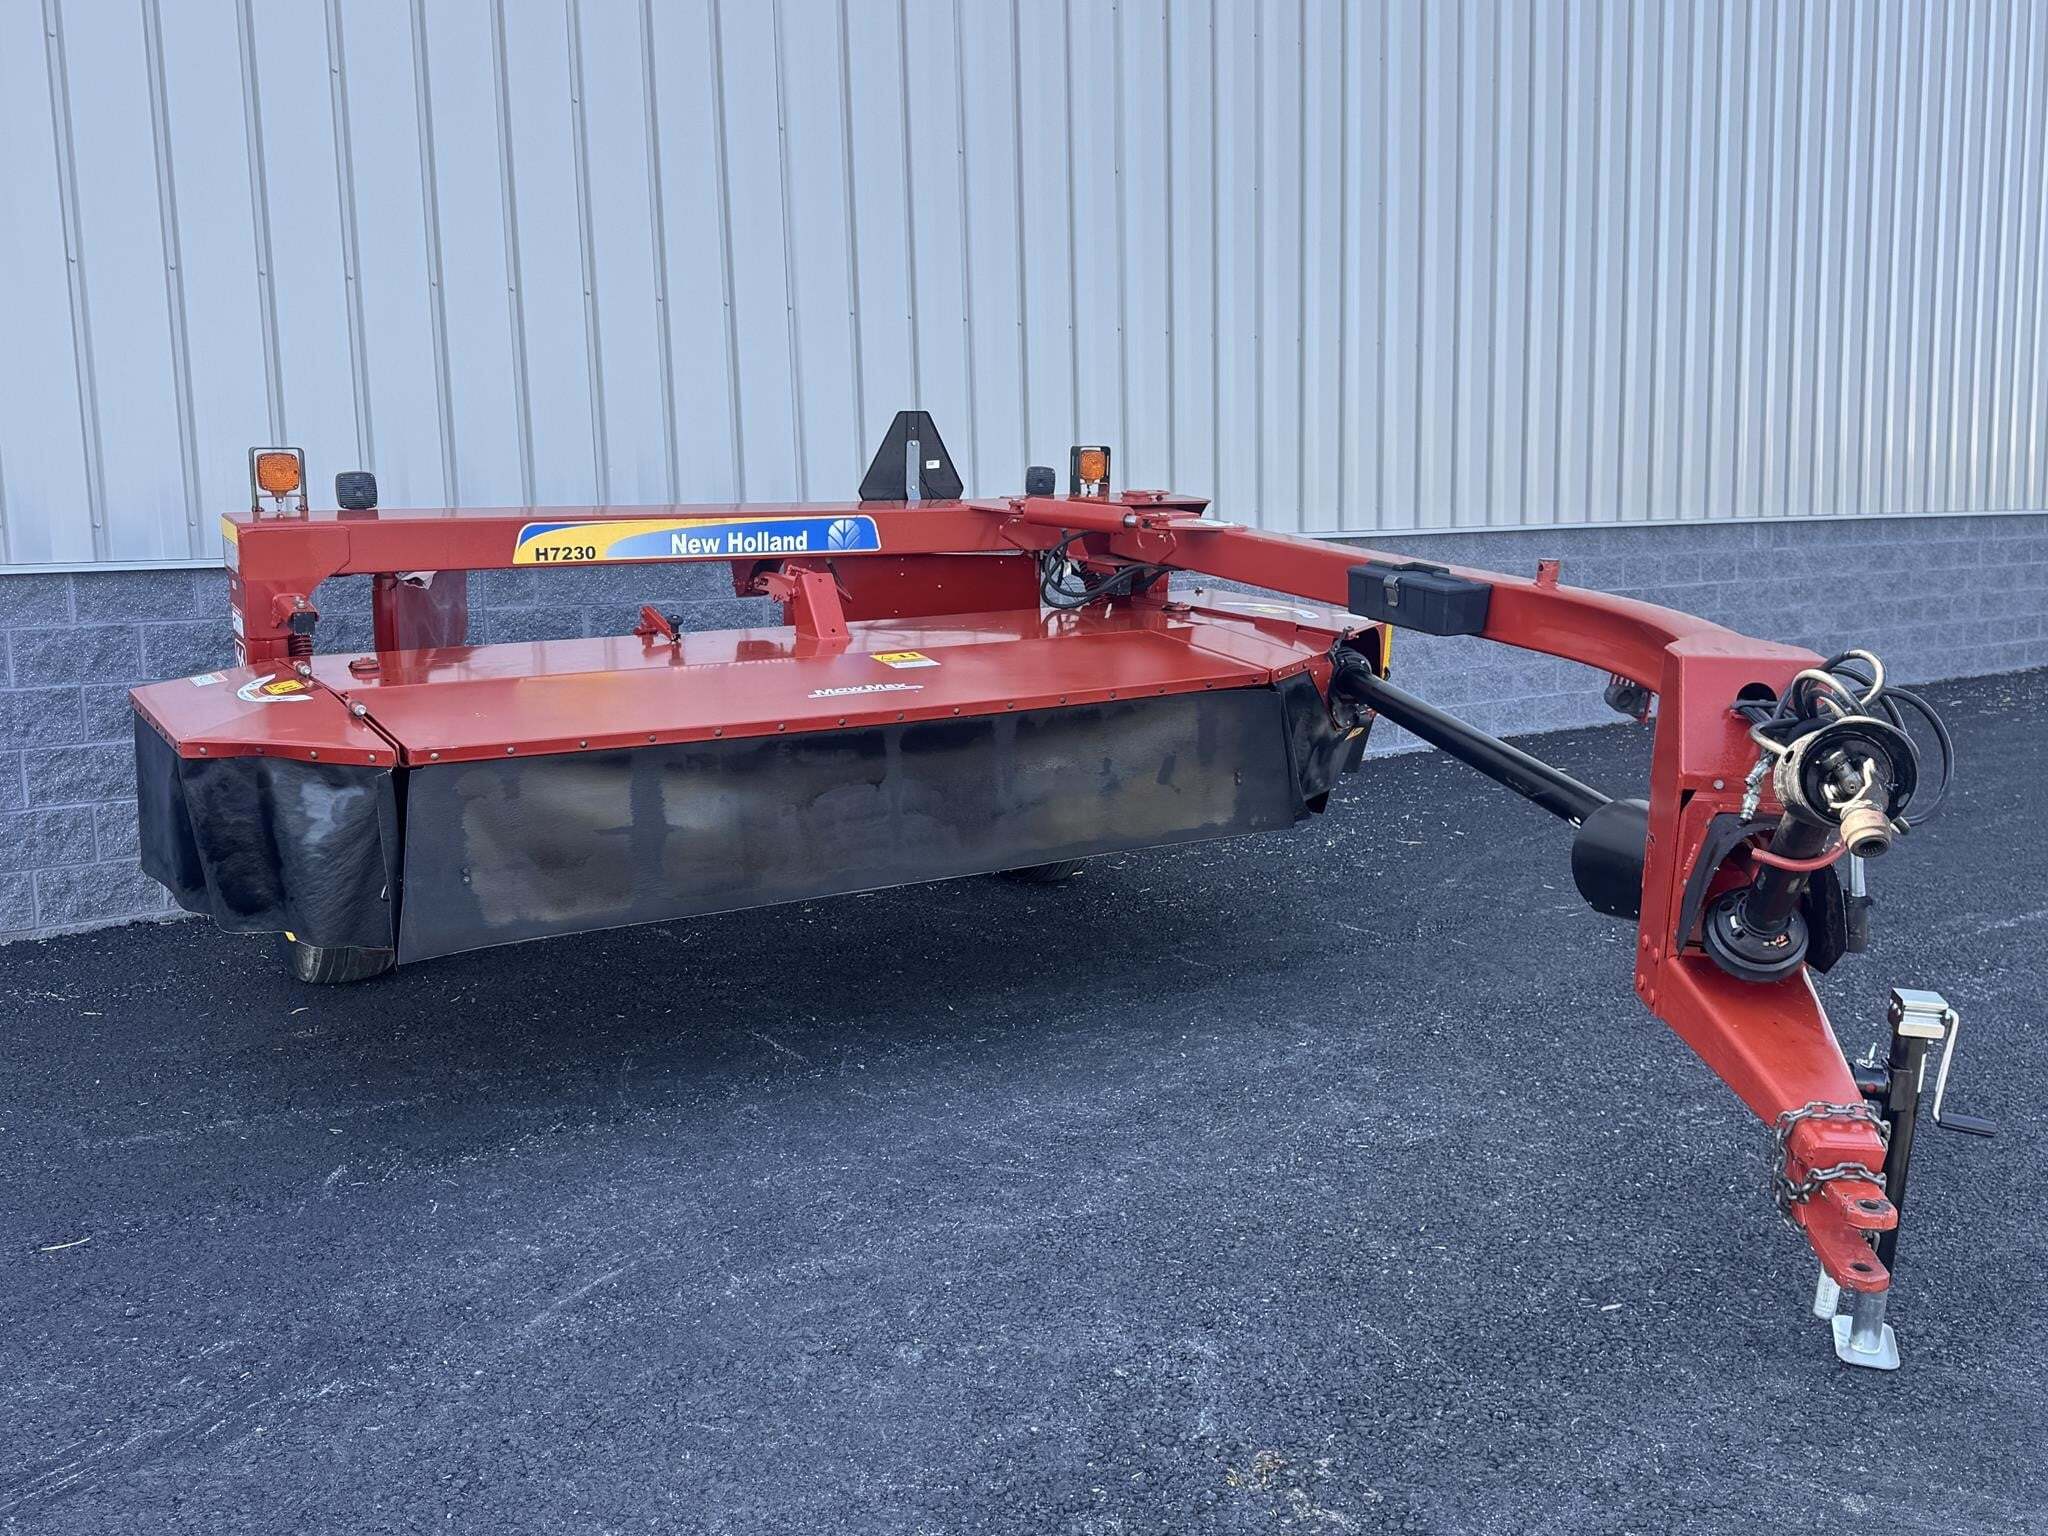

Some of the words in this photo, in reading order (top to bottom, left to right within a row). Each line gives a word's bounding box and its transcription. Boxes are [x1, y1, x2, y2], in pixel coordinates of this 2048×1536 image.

[671, 533, 721, 554] New
[727, 530, 808, 552] Holland
[535, 546, 596, 561] H7230
